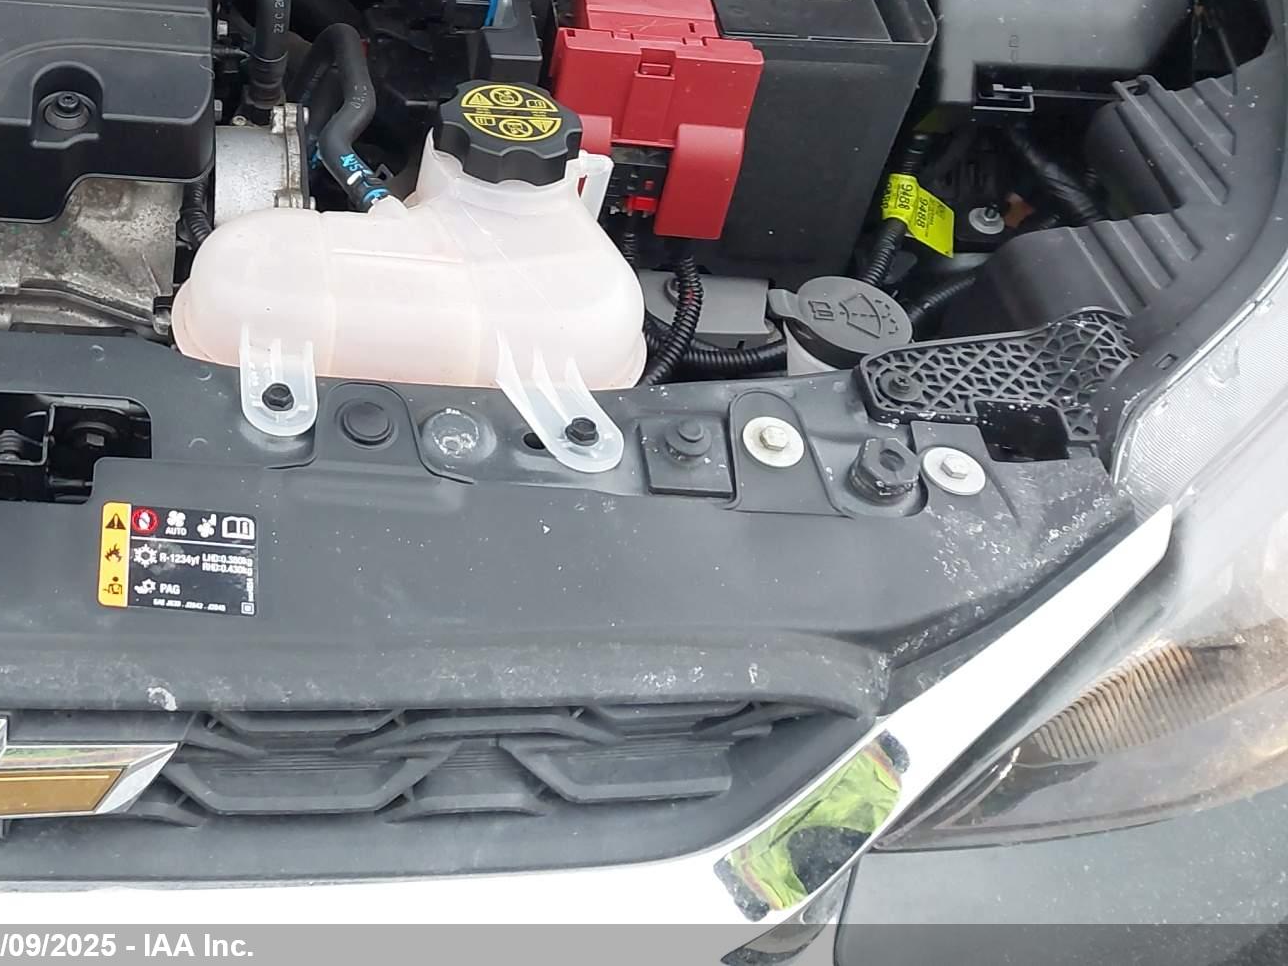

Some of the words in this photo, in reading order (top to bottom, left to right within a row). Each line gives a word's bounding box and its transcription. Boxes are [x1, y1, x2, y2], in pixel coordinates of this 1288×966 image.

[165, 527, 187, 536] AUTO
[159, 553, 200, 567] R-1234yf
[159, 583, 181, 595] PAG
